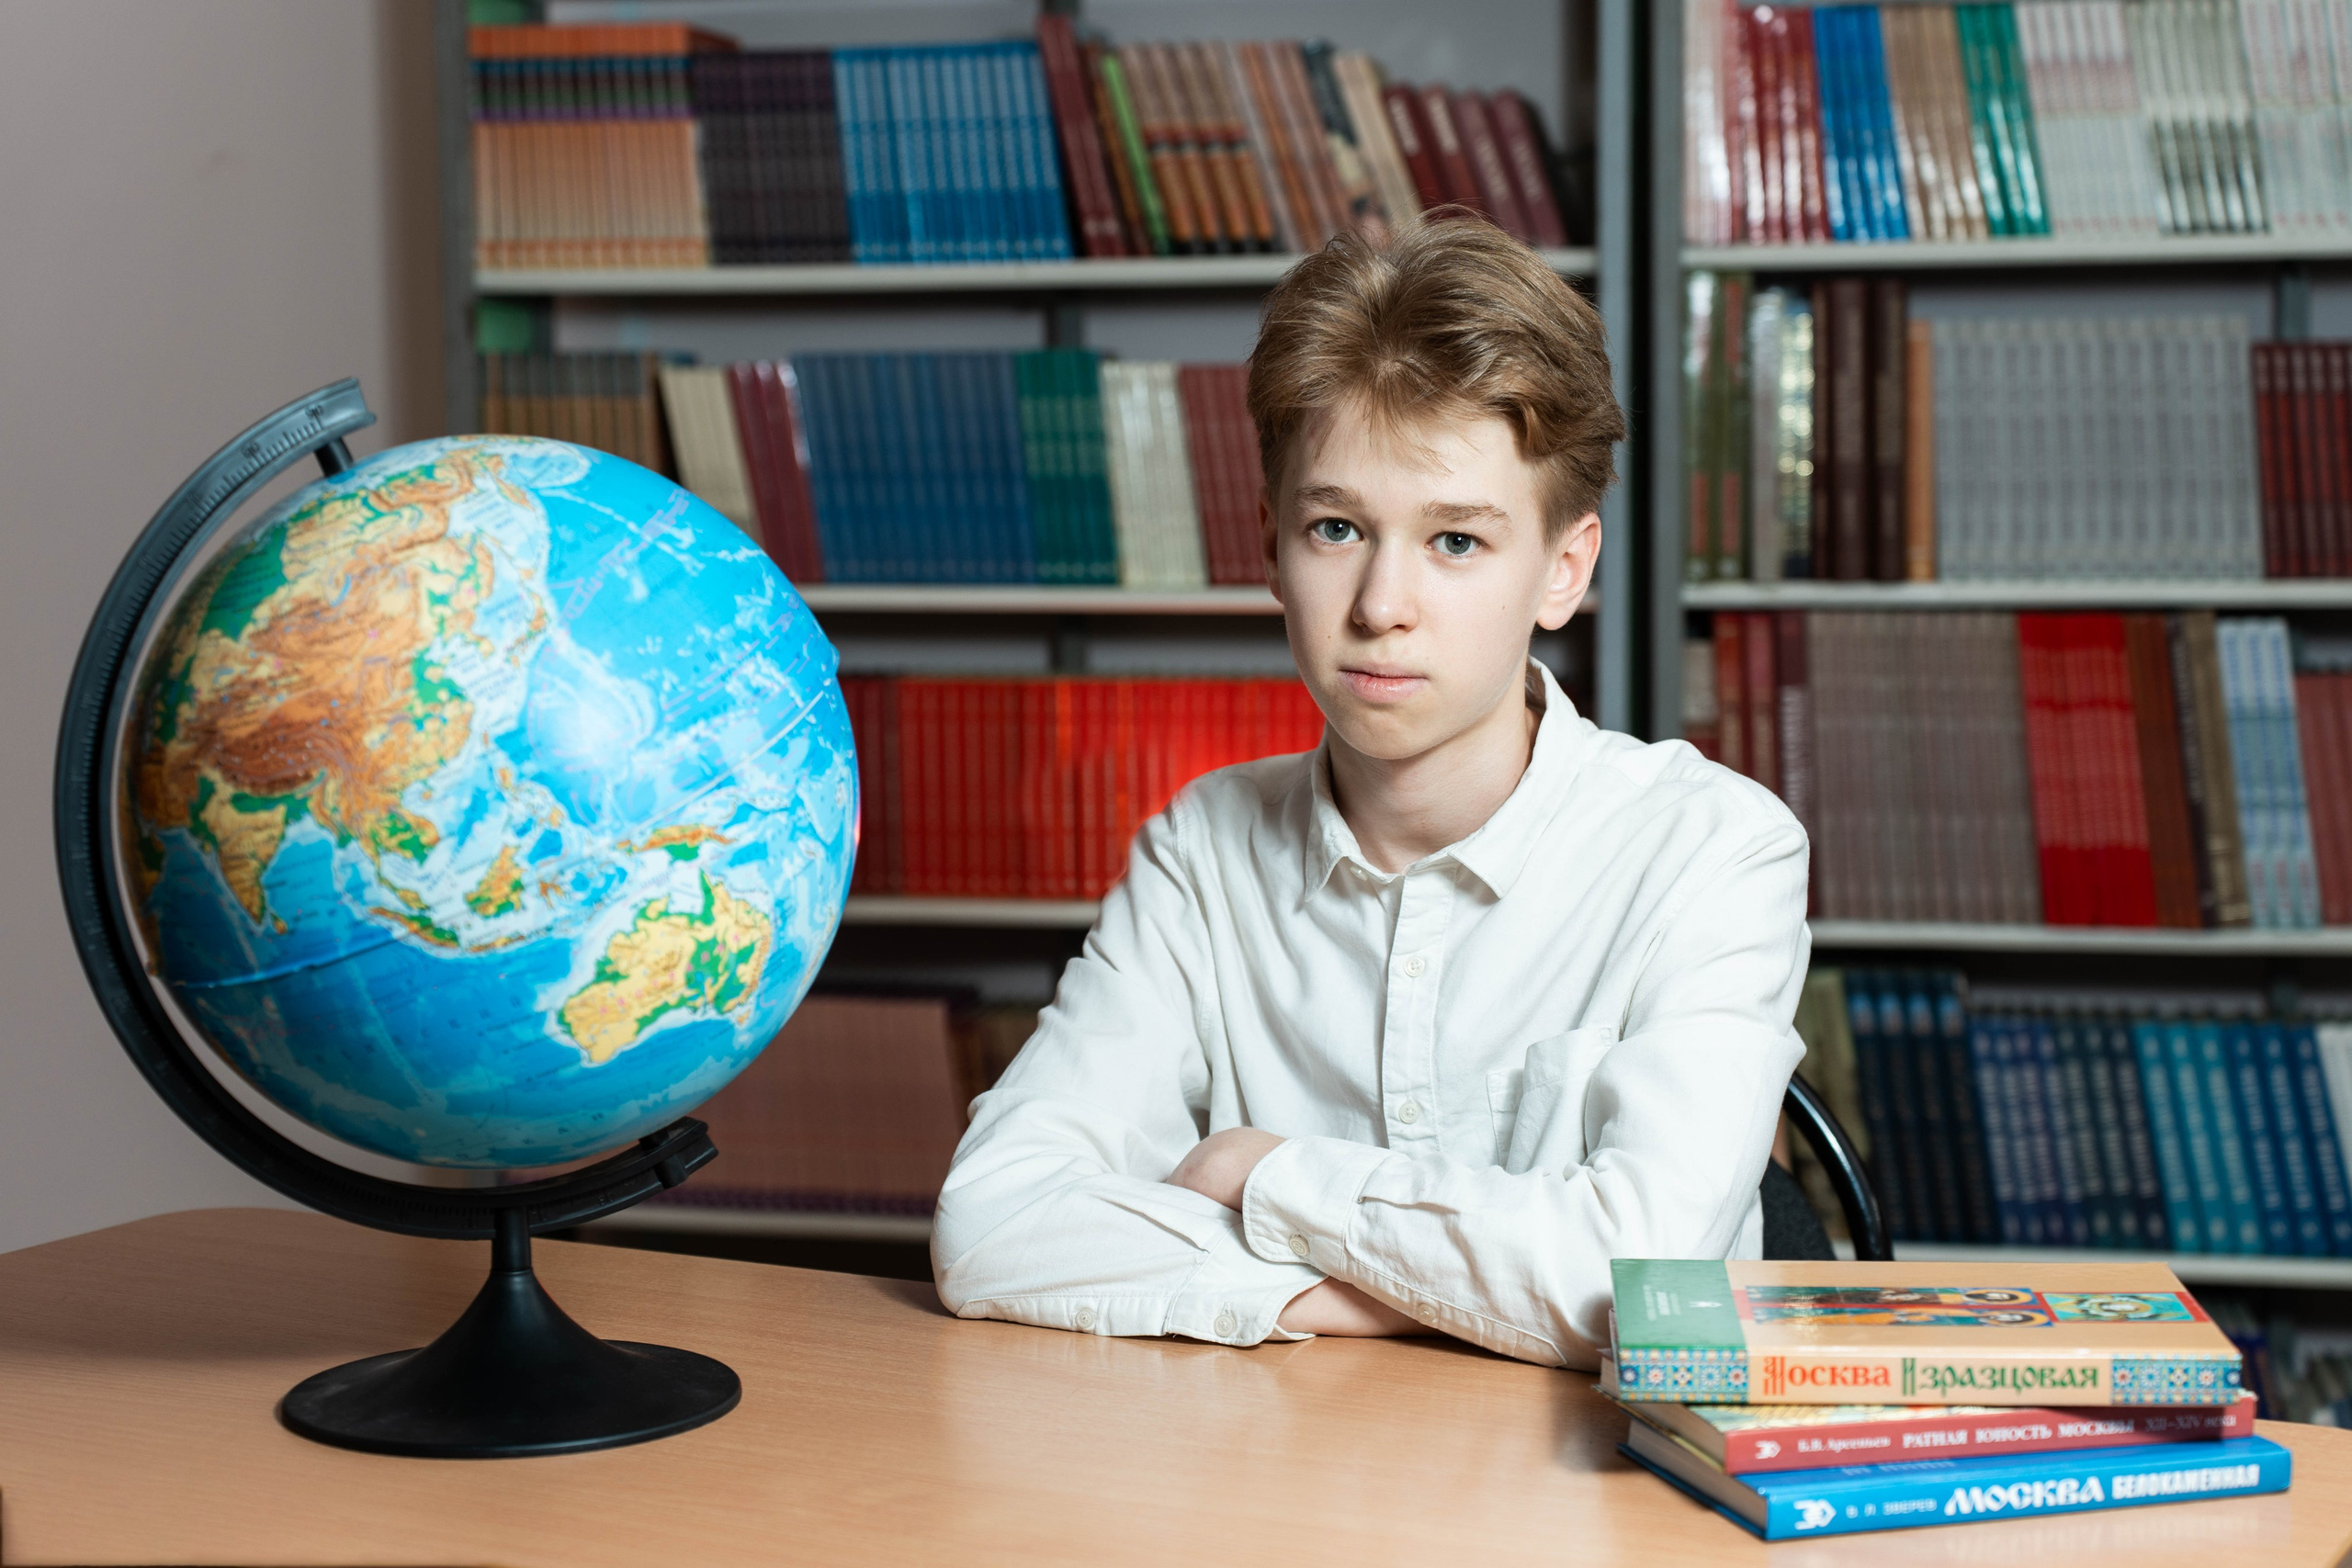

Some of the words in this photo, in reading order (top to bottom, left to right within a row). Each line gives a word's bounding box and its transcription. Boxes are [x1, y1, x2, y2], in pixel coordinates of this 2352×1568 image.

[1762, 1355, 1892, 1396] Москва
[1901, 1357, 2099, 1397] Изразцовая
[1902, 1429, 1969, 1449] РАТНАЯ
[1975, 1424, 2053, 1444] ЮНОСТЬ
[2057, 1418, 2135, 1438] МОСКВЫ
[1943, 1475, 2106, 1517] МОСКВА
[2111, 1463, 2261, 1501] БЕЛОКАМЕННАЯ
